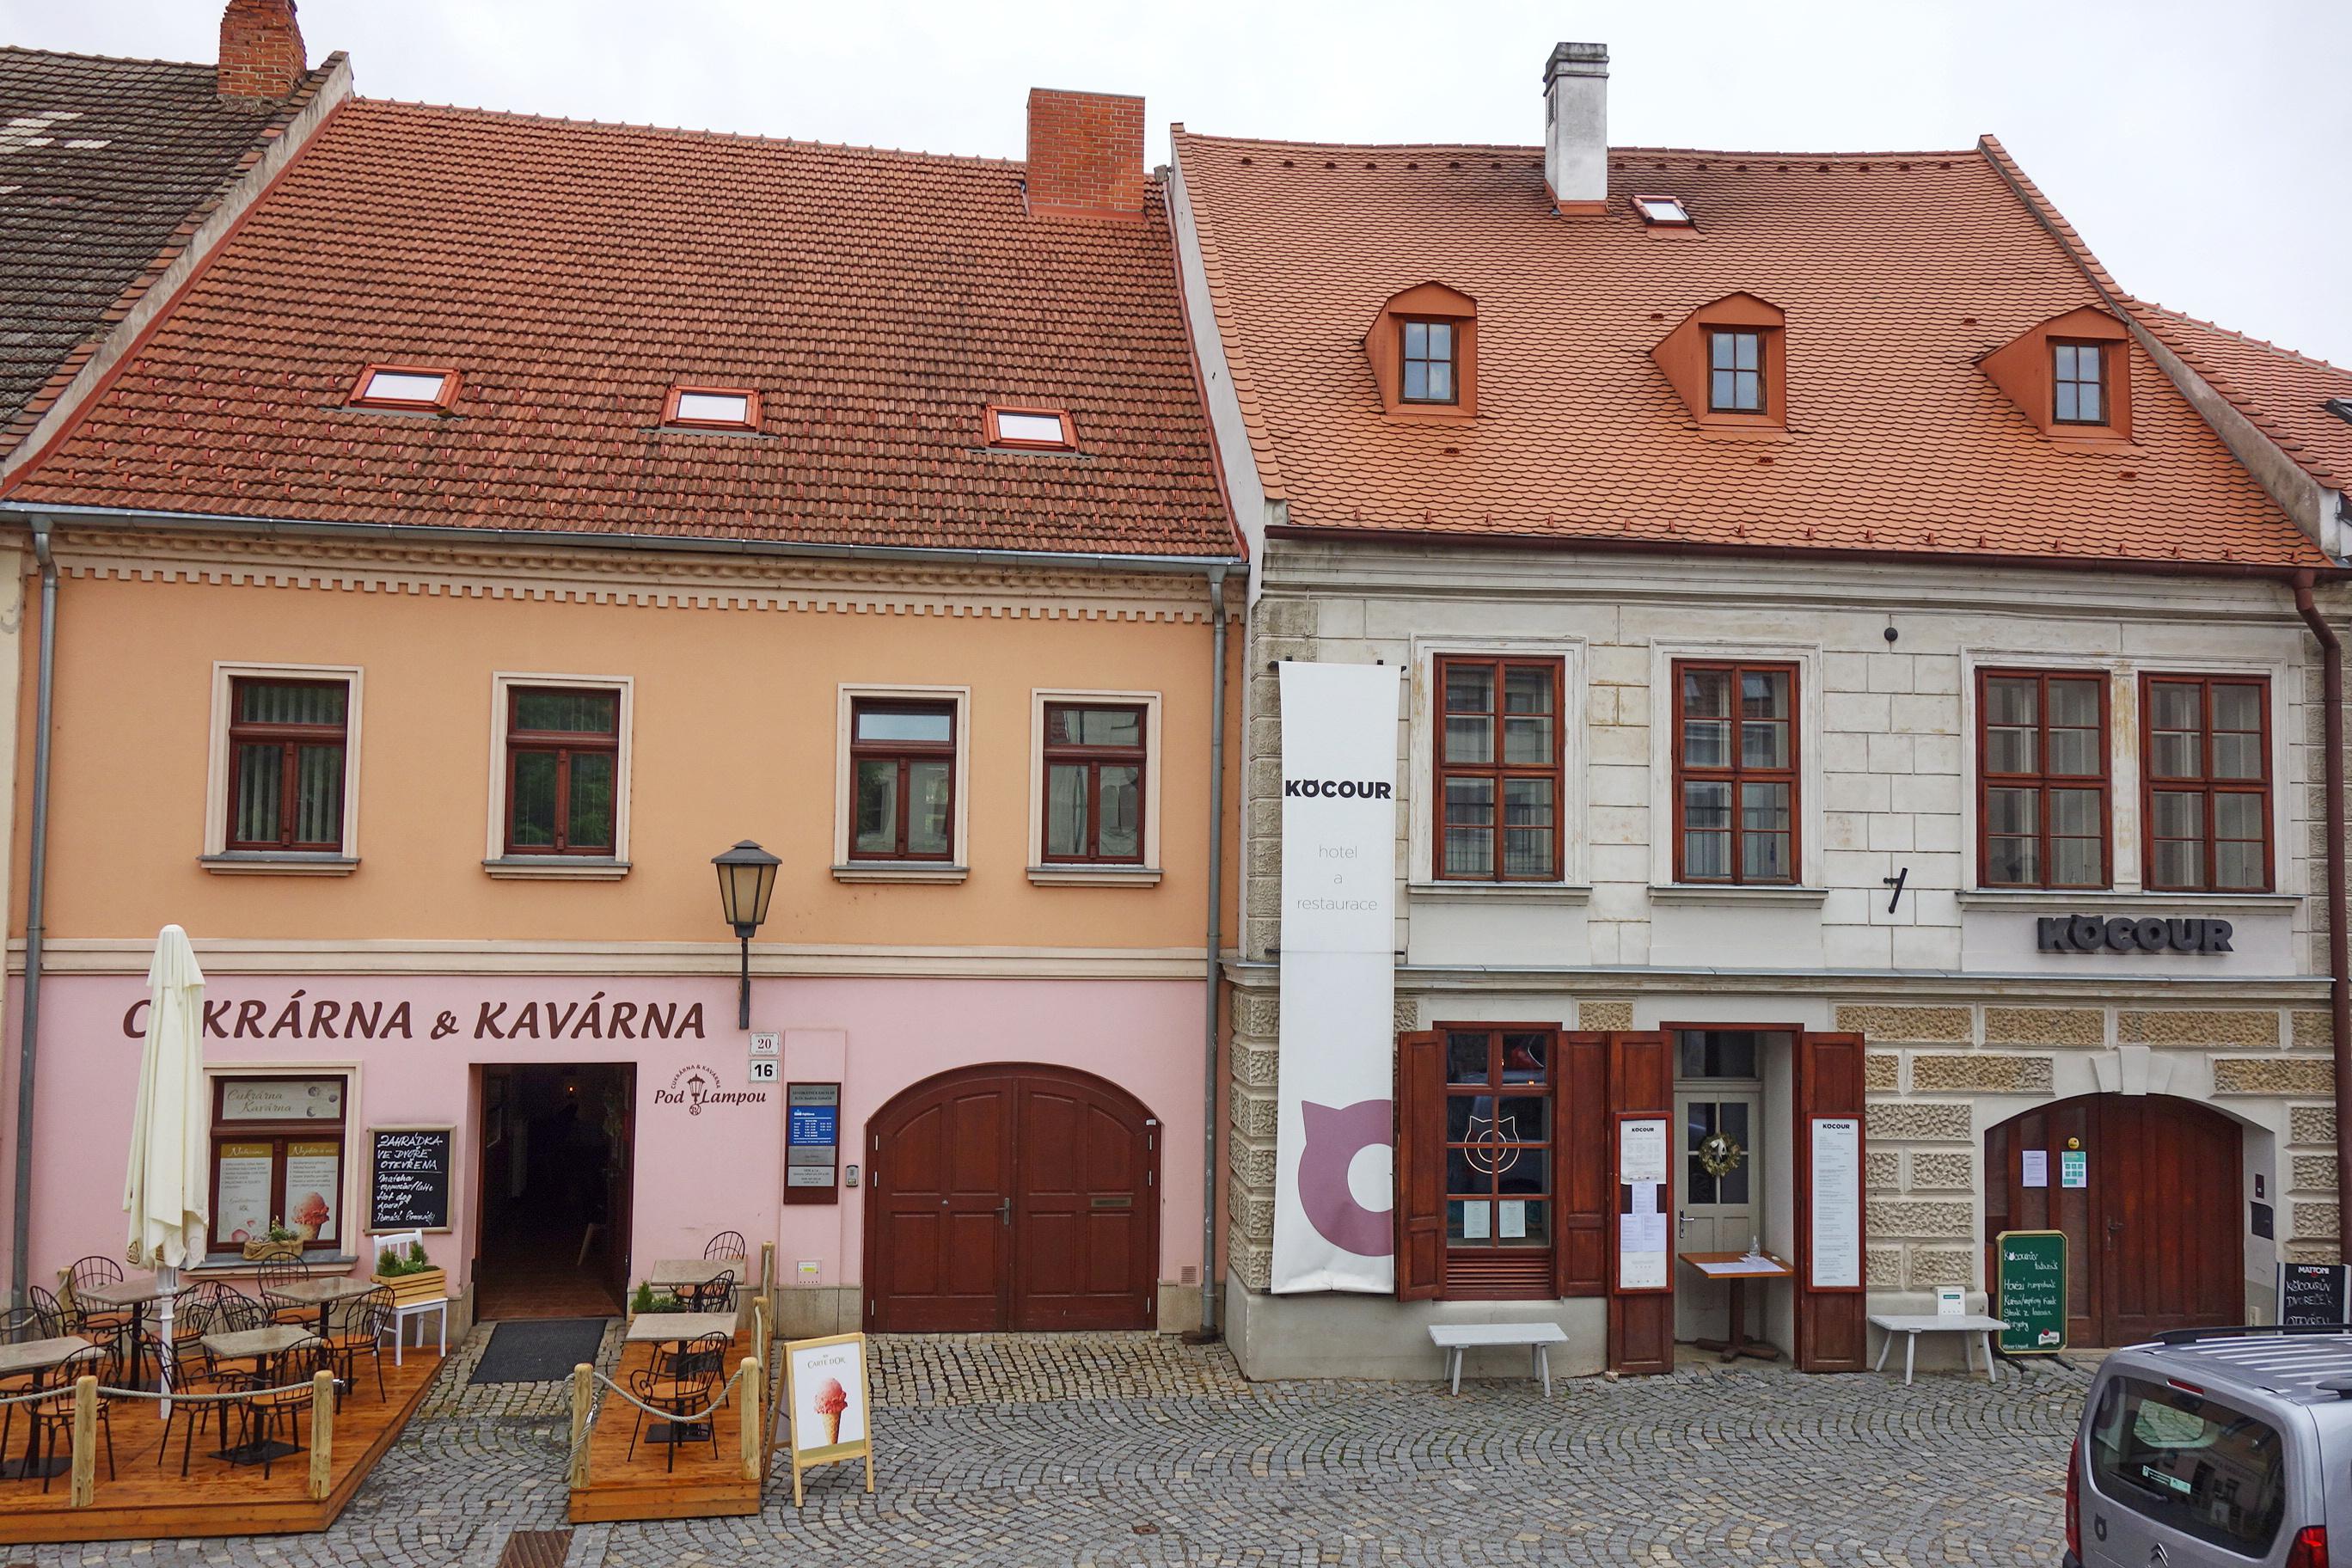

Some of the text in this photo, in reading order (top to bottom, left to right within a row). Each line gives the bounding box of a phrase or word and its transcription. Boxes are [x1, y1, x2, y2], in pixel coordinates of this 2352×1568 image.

[1319, 845, 1357, 859] hotel
[1333, 873, 1343, 885] a
[1297, 897, 1377, 911] restaurace
[123, 989, 706, 1040] CKRÁRNA & KAVÁRNA
[757, 1038, 772, 1050] 20
[671, 1064, 695, 1089] CUKRÁRNA
[701, 1065, 721, 1089] KAVÁRNA
[754, 1063, 774, 1077] 16
[227, 1088, 283, 1101] Cukrárna
[654, 1089, 767, 1106] Pod Lampou
[240, 1100, 292, 1114] Kavárna
[377, 1132, 444, 1148] ZAHRÁDKA
[377, 1146, 432, 1159] VE DVOŘE
[380, 1158, 438, 1170] OTEVŘENA
[377, 1191, 413, 1204] Hot dog
[2298, 1265, 2330, 1275] MATTONI
[807, 1360, 827, 1369] CARTE
